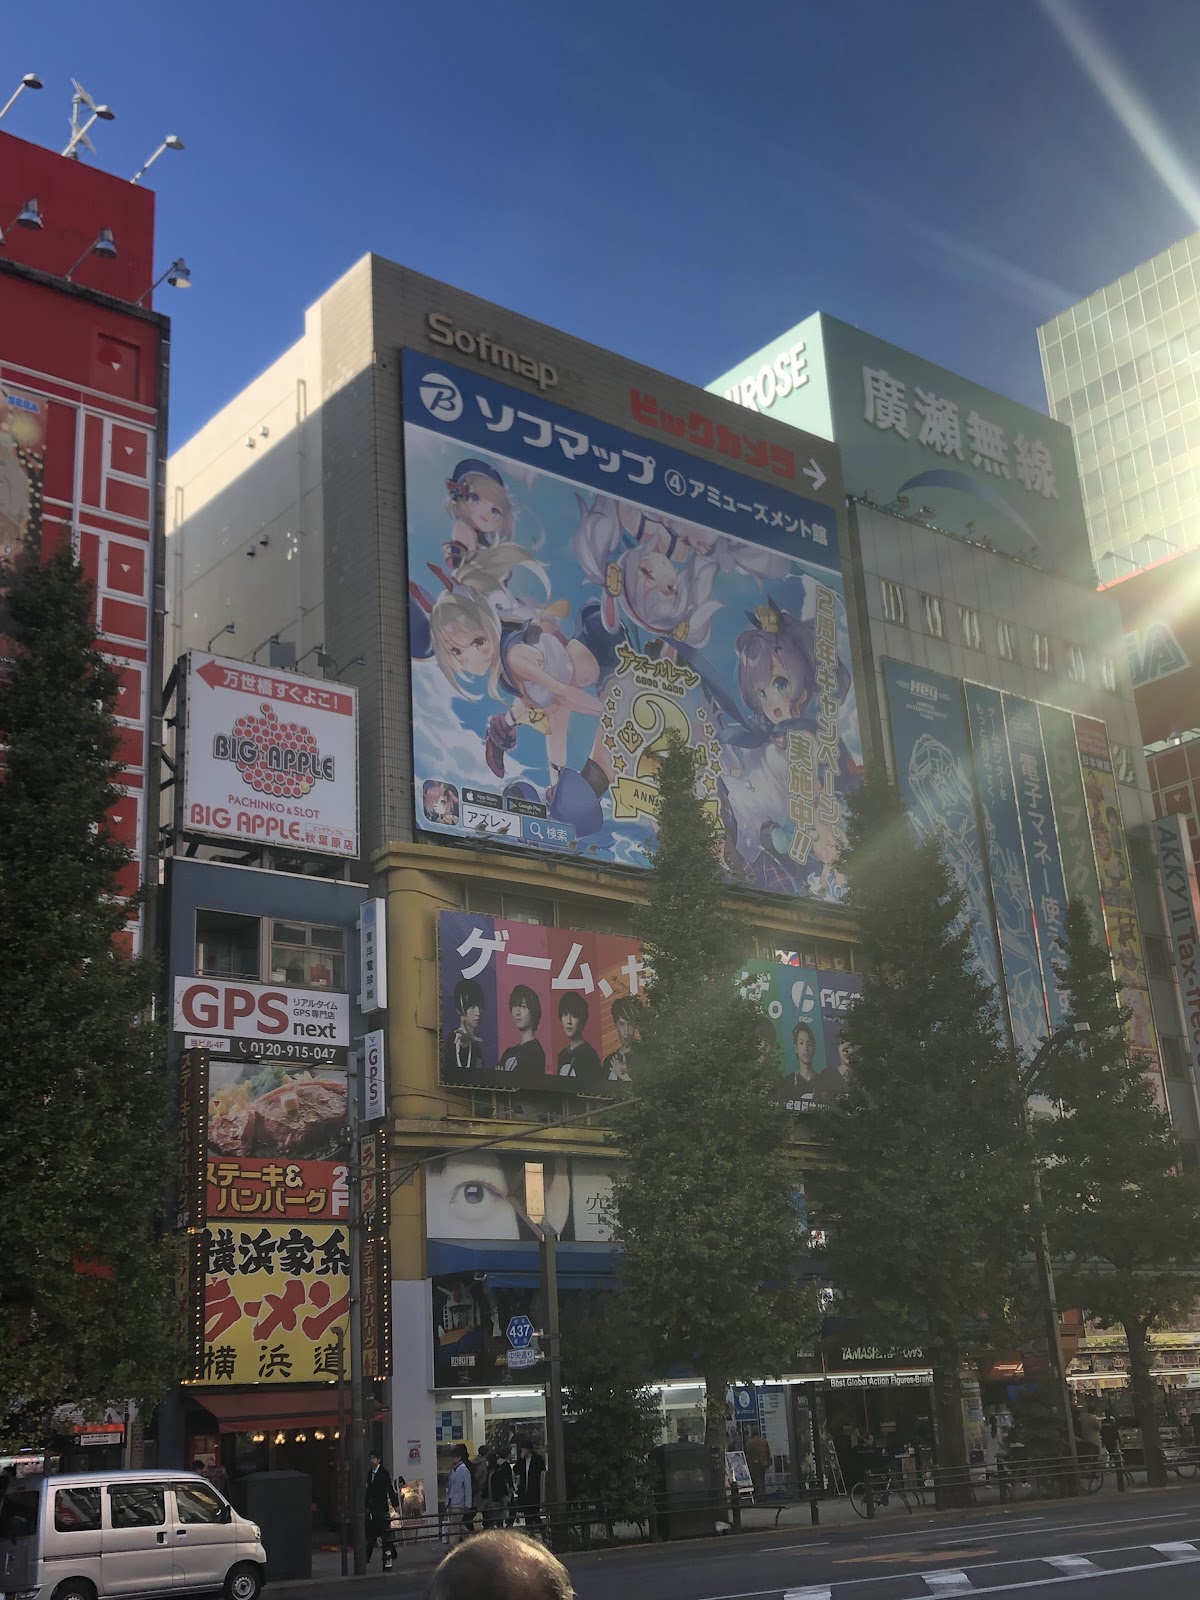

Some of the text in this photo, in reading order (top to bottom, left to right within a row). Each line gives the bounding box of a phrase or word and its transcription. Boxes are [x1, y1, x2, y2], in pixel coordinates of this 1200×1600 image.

[426, 311, 559, 391] Sofmap
[7, 394, 41, 414] SEGA
[476, 394, 656, 486] ソフマップ
[629, 388, 796, 480] ビックカメラ
[862, 365, 1060, 500] 廣瀬無線
[616, 643, 700, 688] アズールレーン
[213, 732, 335, 783] BIG APPLE
[190, 802, 232, 829] BIG
[228, 794, 320, 820] PACHINKO & SLOT
[467, 811, 511, 831] アズレン
[305, 831, 354, 851] 秋葉原店
[546, 826, 568, 842] 検索
[1157, 825, 1188, 902] AKKY
[181, 984, 290, 1035] GPS
[293, 997, 339, 1011] リアルタイム
[293, 1021, 337, 1039] next
[250, 1041, 337, 1060] 0120-915-047
[369, 1047, 379, 1101] GPS
[217, 1187, 329, 1213] ハンバーグ
[202, 1227, 349, 1276] 横浜家系
[204, 1276, 350, 1344] ラーメン
[509, 1323, 531, 1338] 437
[201, 1343, 347, 1381] 横浜道
[830, 1374, 934, 1388] Best Global Action Figures Brand
